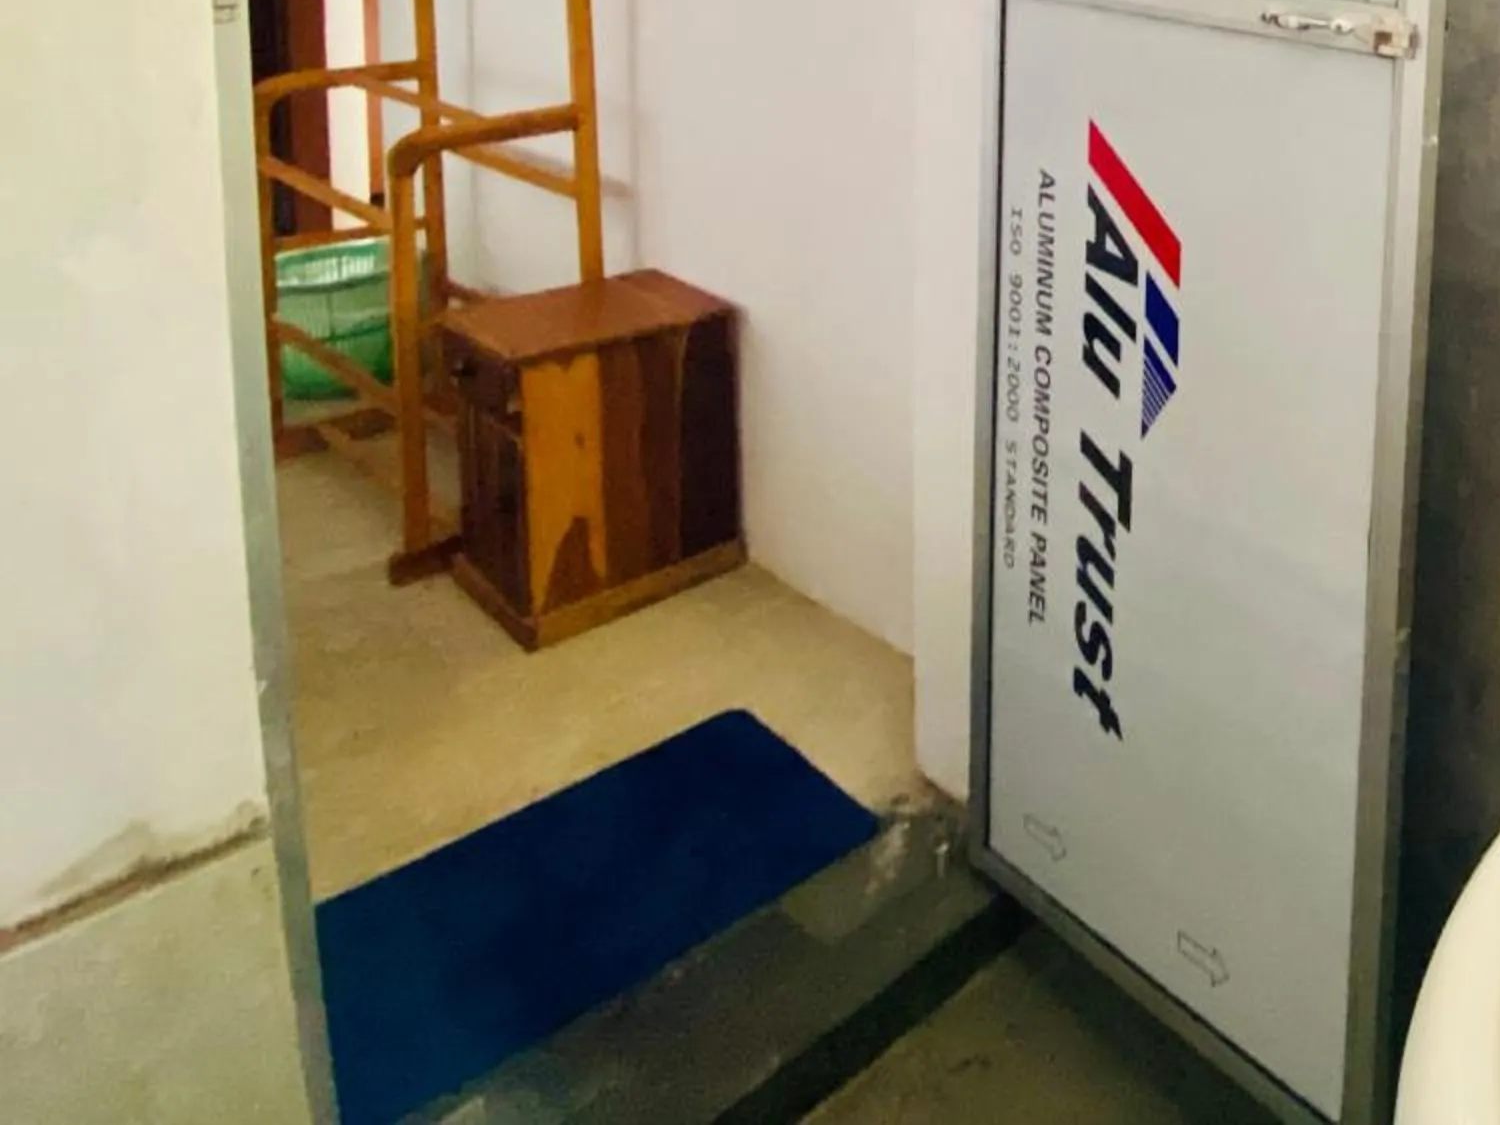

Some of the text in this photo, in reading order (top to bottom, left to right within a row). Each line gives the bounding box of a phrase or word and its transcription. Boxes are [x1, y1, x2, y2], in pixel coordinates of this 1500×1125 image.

[1003, 205, 1023, 570] ISO 9001:2000 STANDARD
[1027, 167, 1056, 626] ALUMINUM COMPOSITE PANEL
[1072, 181, 1139, 742] Alu Trust
